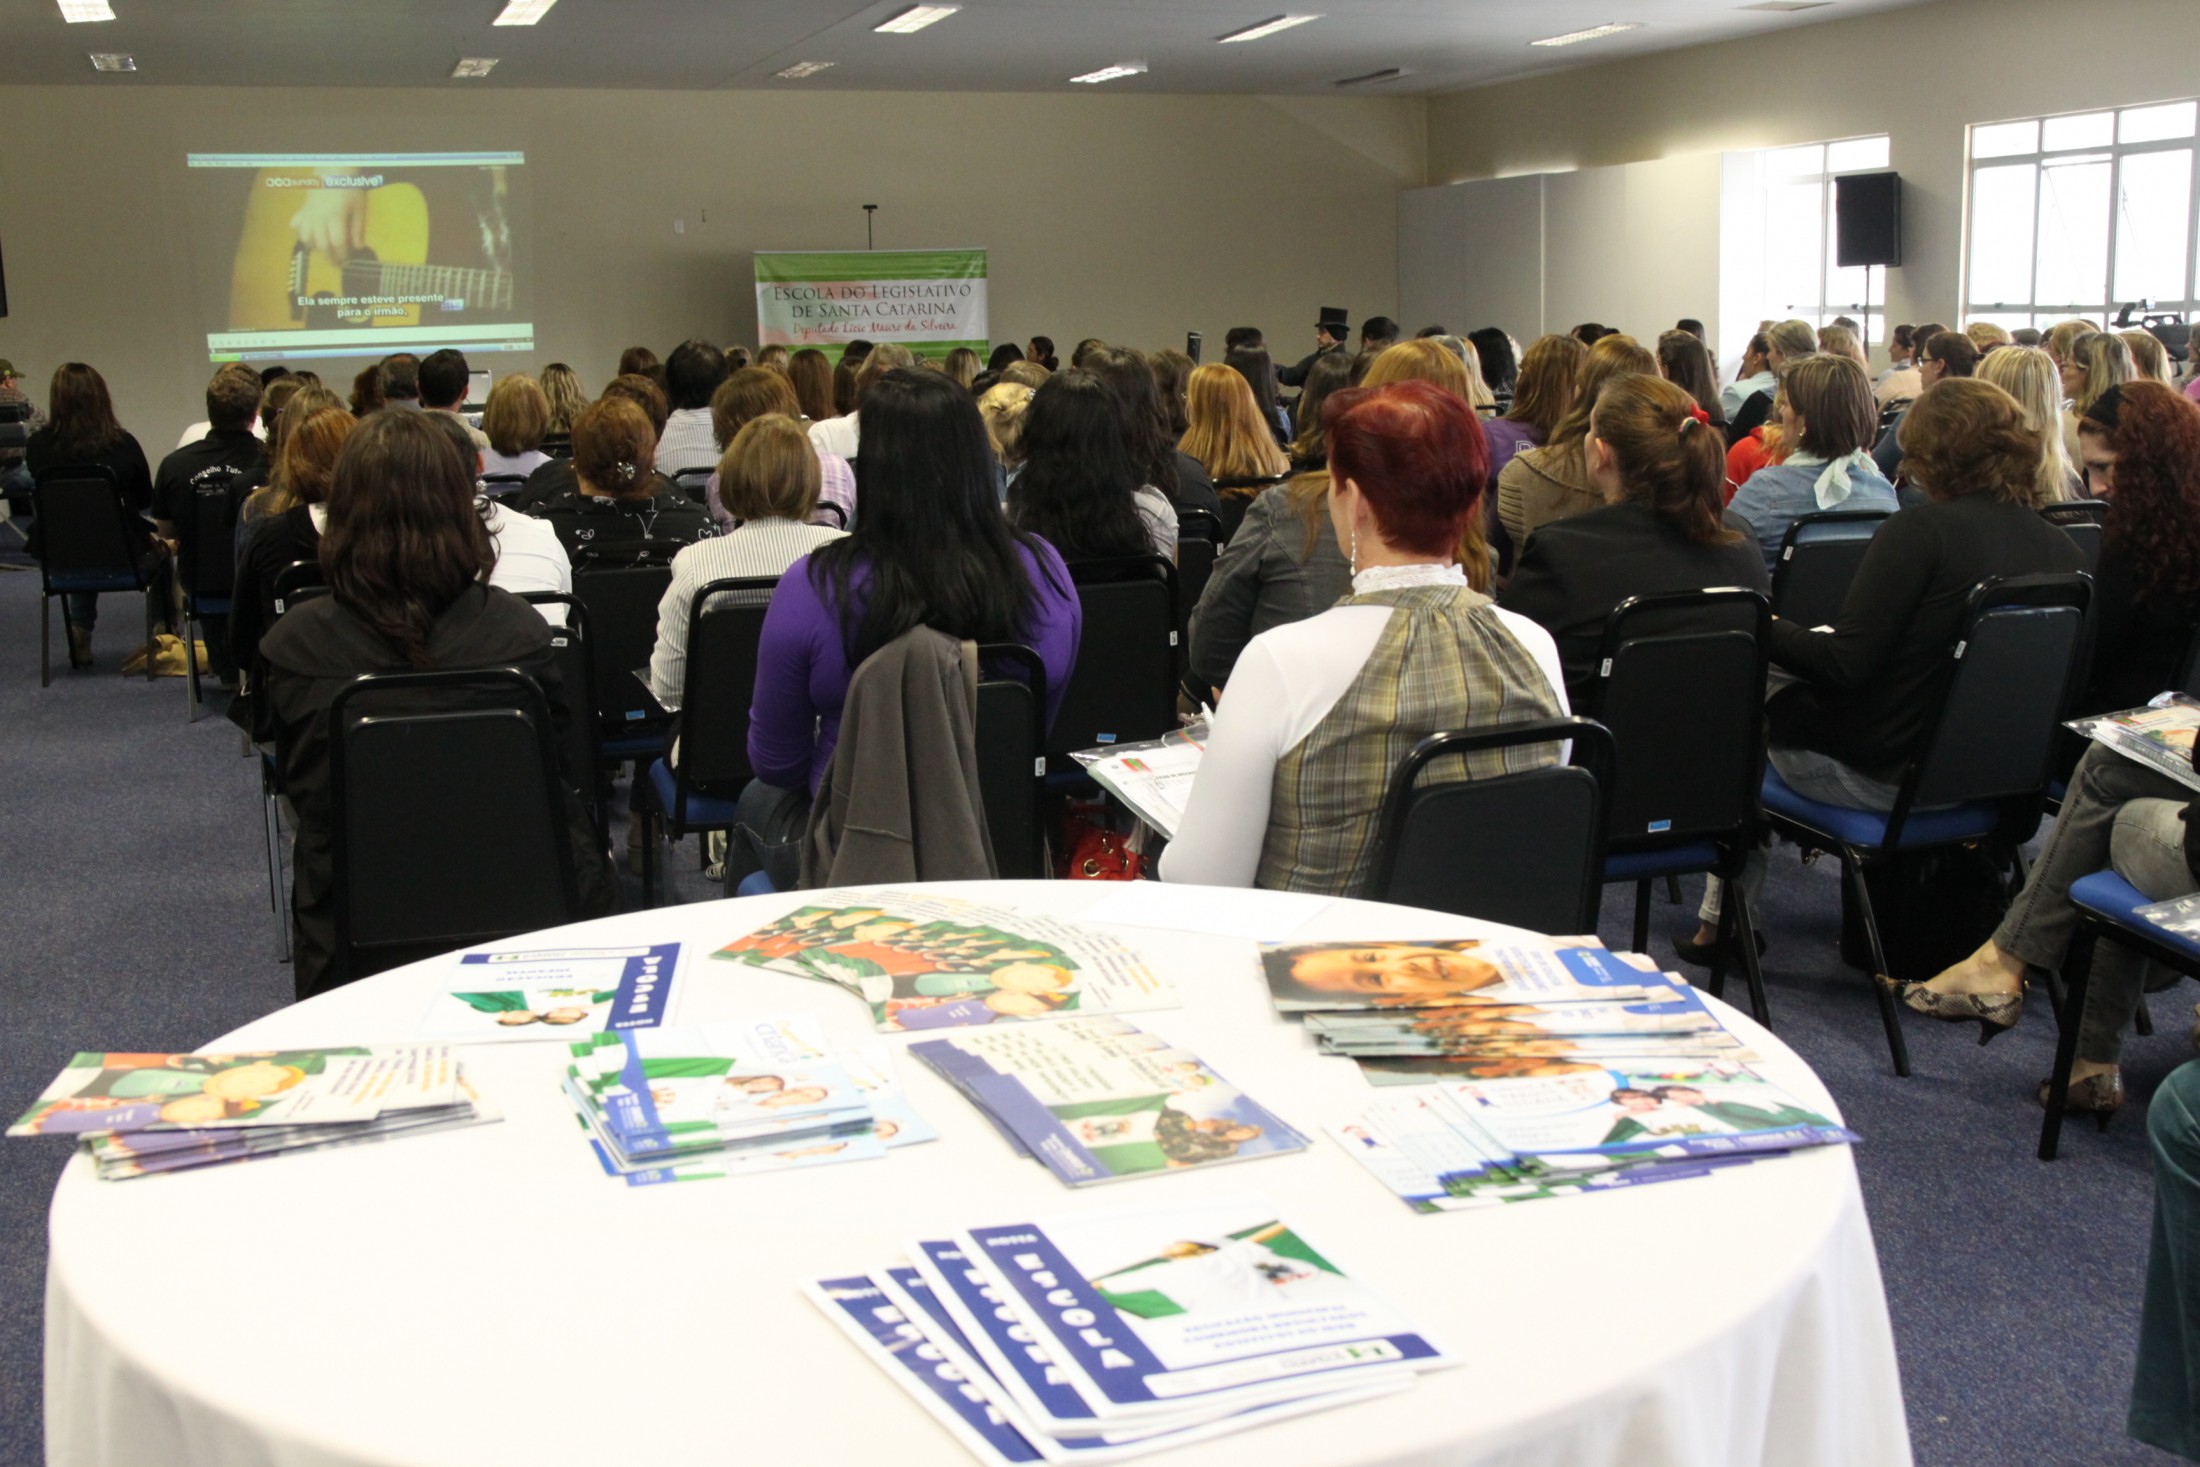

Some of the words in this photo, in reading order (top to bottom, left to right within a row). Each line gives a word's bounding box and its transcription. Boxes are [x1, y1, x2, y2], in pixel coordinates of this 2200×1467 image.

[325, 175, 378, 187] exclusive
[297, 296, 315, 306] Ela
[317, 295, 358, 308] sempre
[360, 294, 395, 305] esteve
[398, 292, 444, 306] presente
[774, 285, 835, 301] ESCOLA
[841, 286, 867, 300] DO
[873, 283, 972, 299] LEGISLATIVO
[336, 308, 362, 319] para
[363, 309, 372, 317] o
[373, 306, 408, 317] irmão.
[792, 304, 813, 318] DE
[819, 302, 870, 318] SANTA
[875, 301, 956, 317] CATARINA
[793, 321, 839, 340] Deputado
[870, 320, 902, 333] Mauro
[904, 319, 917, 332] da
[920, 318, 957, 332] Silveira
